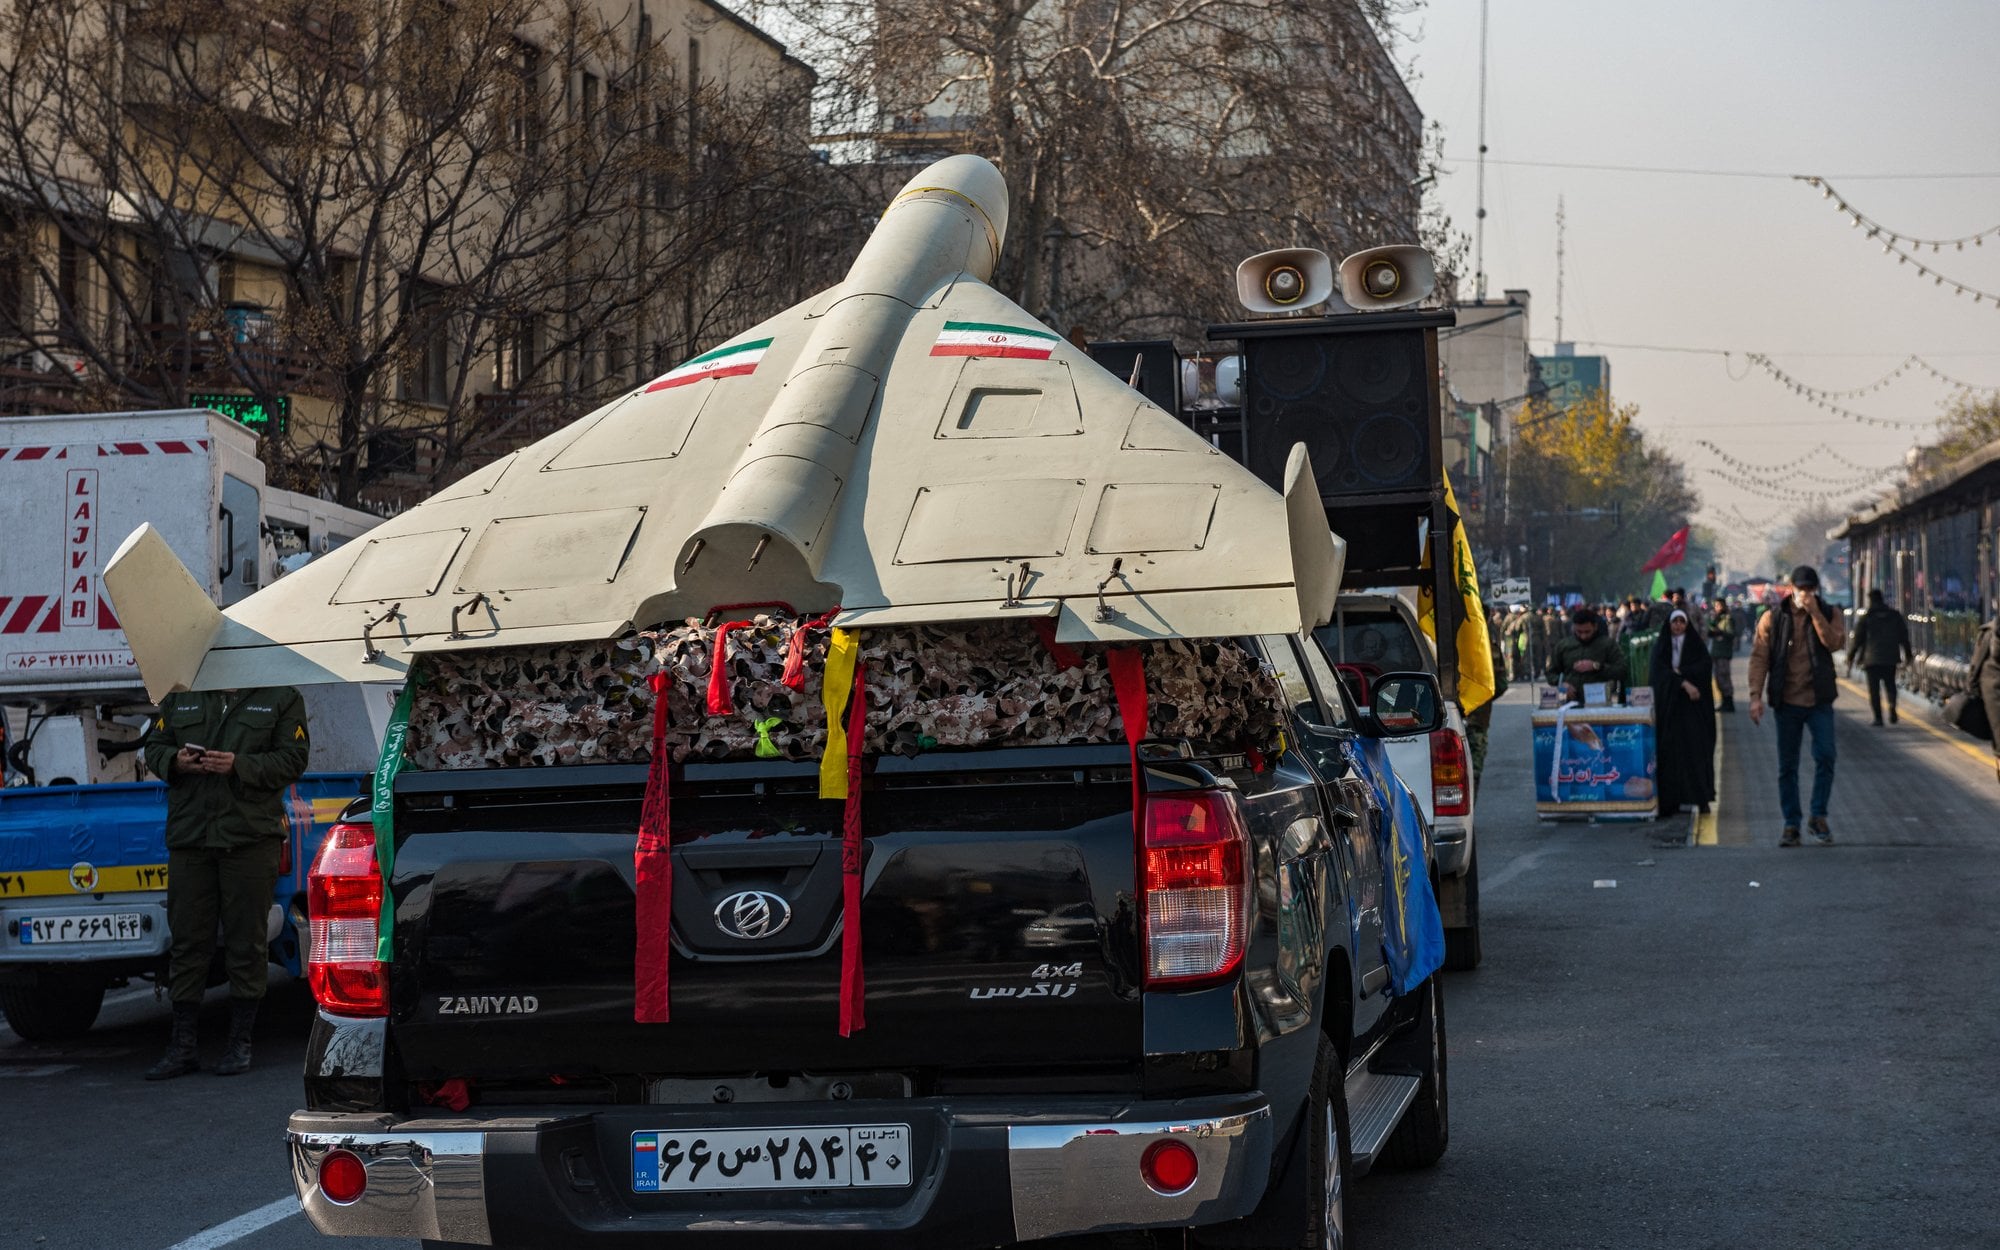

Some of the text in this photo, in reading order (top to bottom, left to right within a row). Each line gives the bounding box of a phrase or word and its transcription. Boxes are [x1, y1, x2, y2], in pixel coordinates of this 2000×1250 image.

[71, 477, 90, 618] LAJVAR
[1031, 962, 1083, 979] 4x4
[439, 996, 539, 1014] ZAMYAD
[858, 1130, 900, 1139] ایران
[636, 1179, 657, 1187] IRAN
